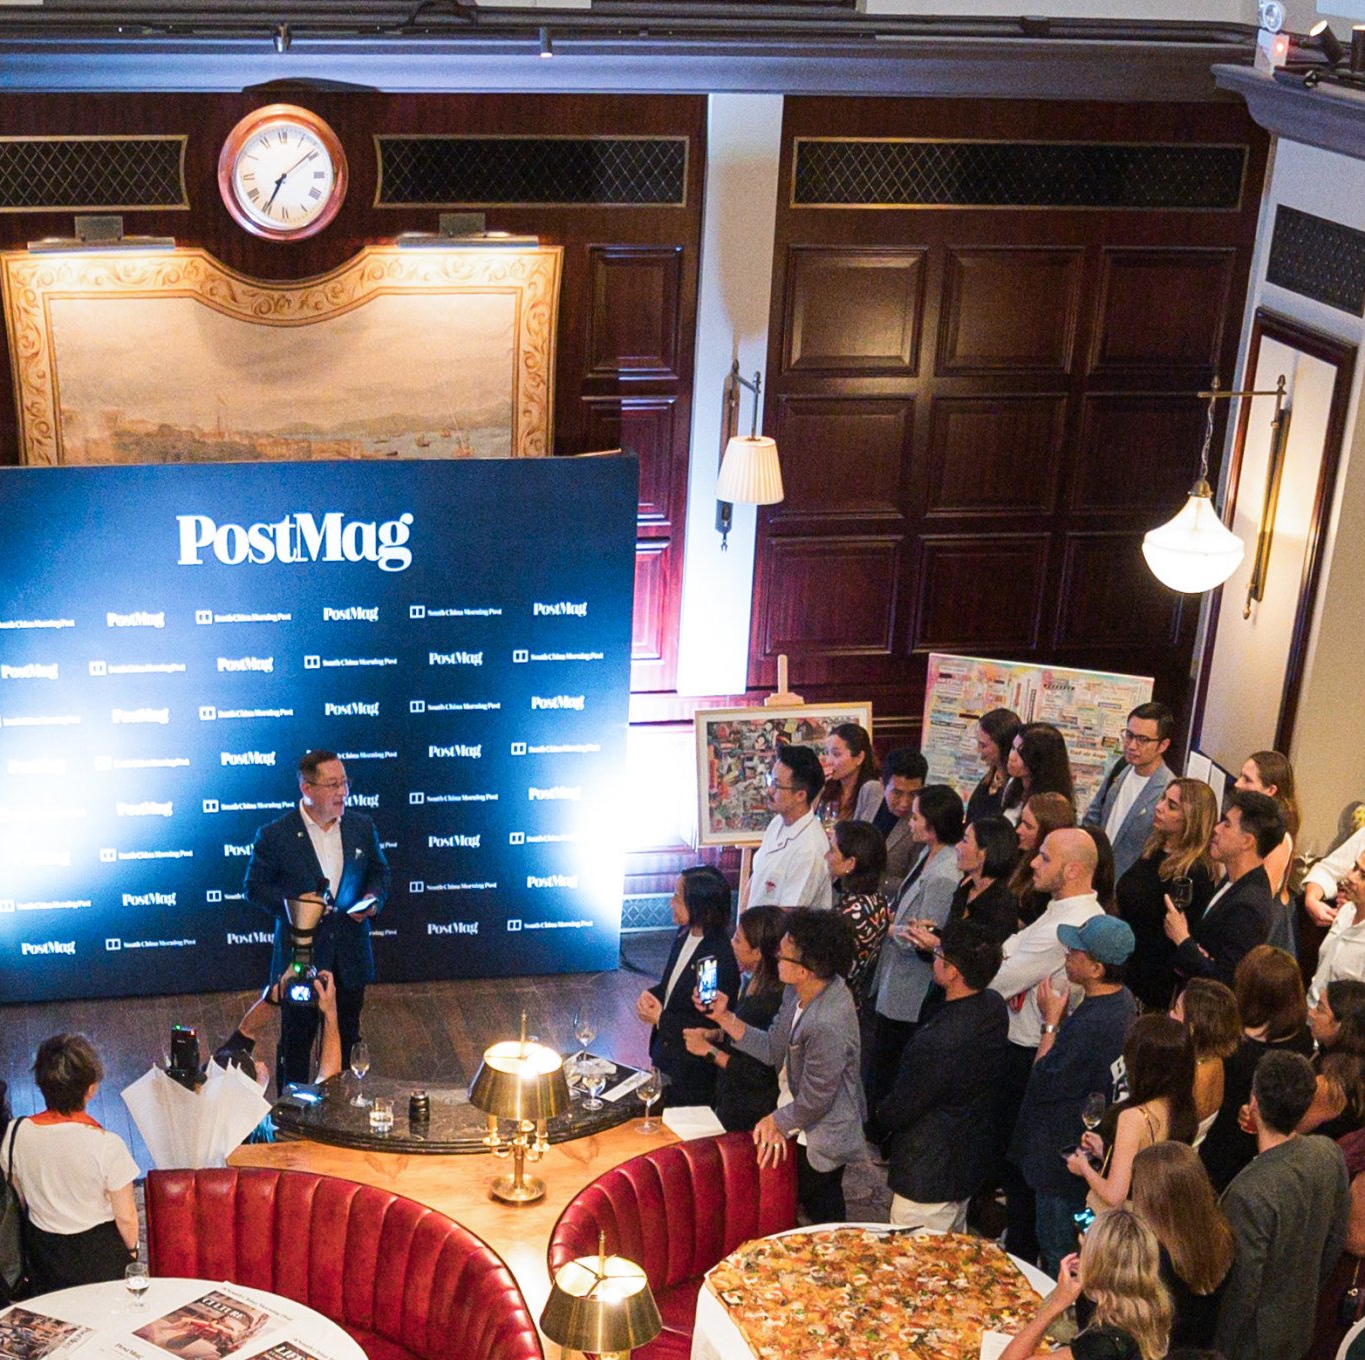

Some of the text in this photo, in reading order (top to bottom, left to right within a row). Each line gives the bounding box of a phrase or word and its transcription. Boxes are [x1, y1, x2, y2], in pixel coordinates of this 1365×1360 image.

[176, 512, 414, 572] PostMag
[323, 606, 379, 622] PostMag
[533, 602, 587, 617] PostMag
[429, 651, 483, 666] PostMag
[325, 702, 379, 716] PostMag
[221, 751, 276, 766] PostMag
[428, 744, 482, 759] PostMag
[428, 834, 480, 848] PostMag
[122, 892, 176, 907] PostMag
[427, 922, 479, 935] PostMag
[21, 941, 75, 955] PostMag
